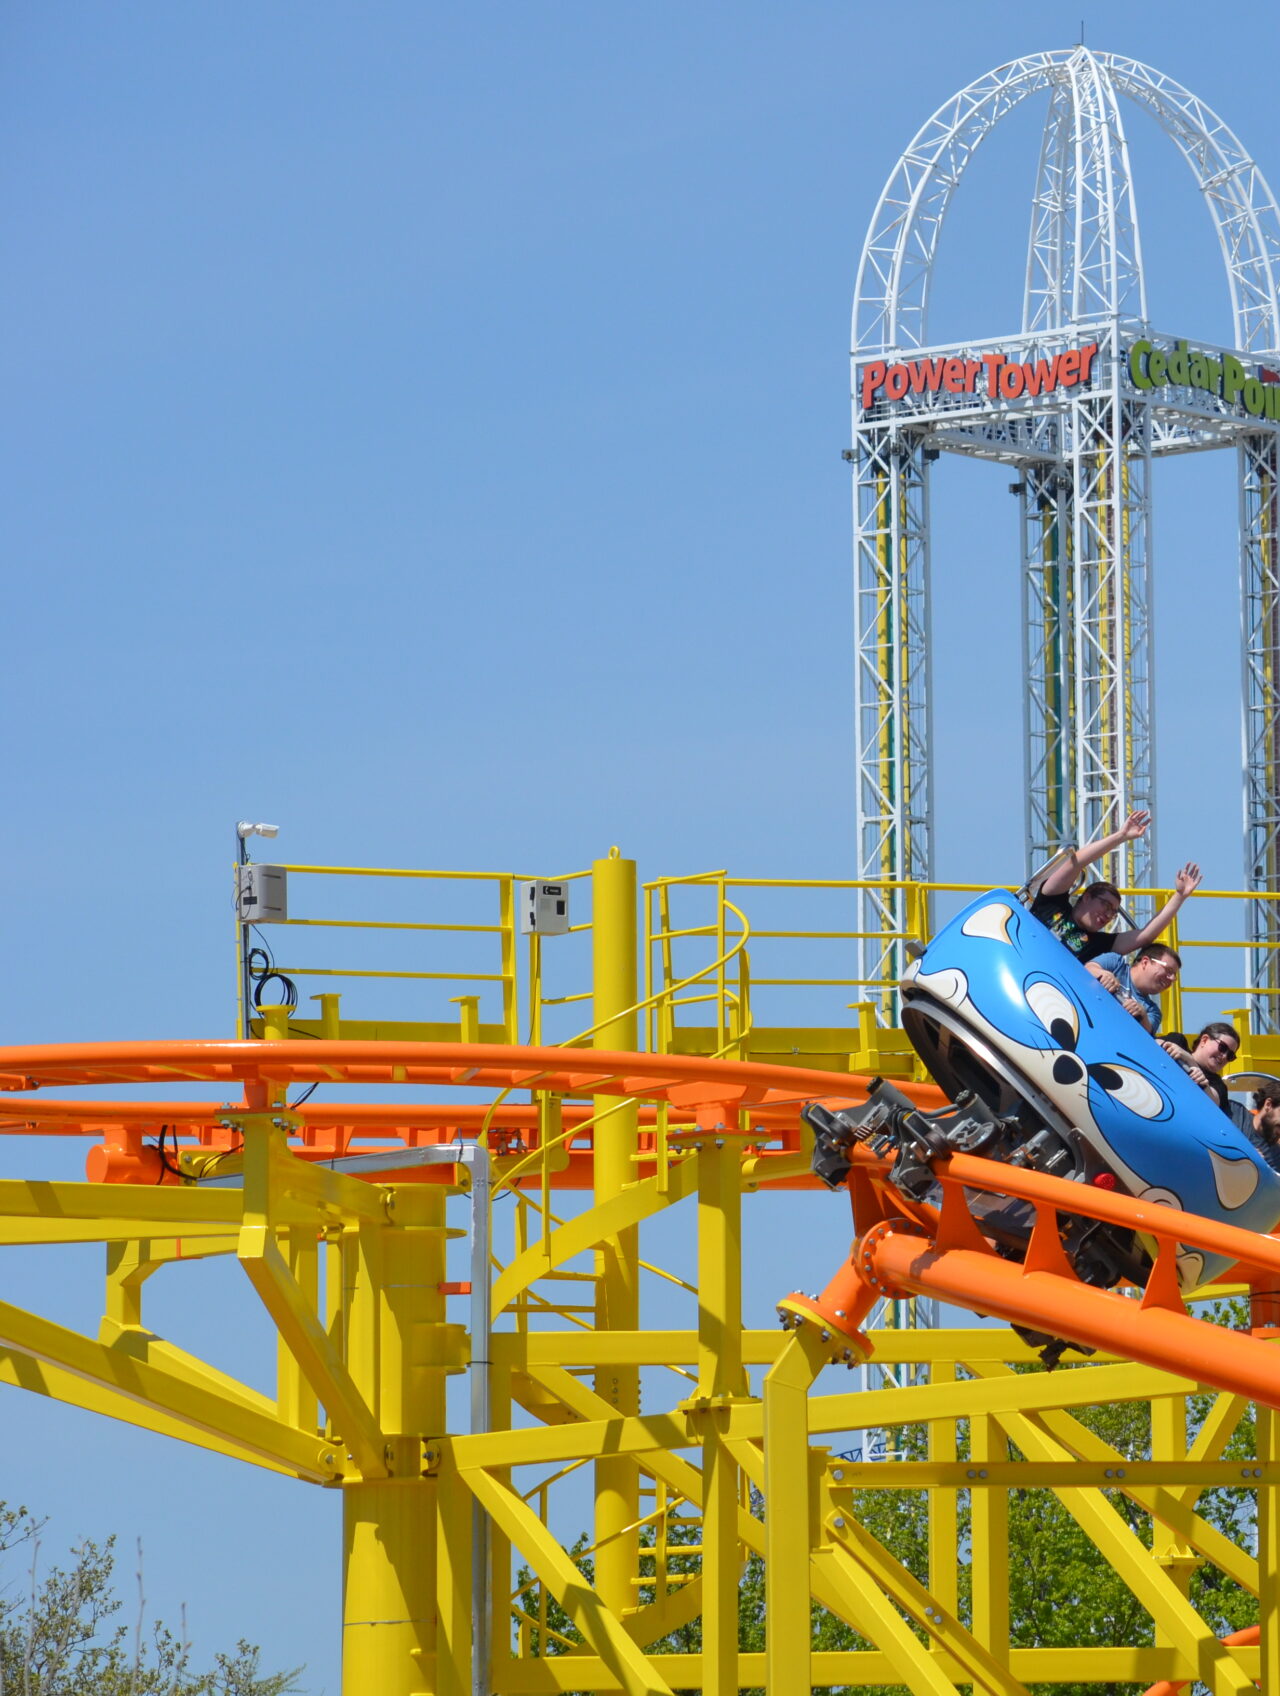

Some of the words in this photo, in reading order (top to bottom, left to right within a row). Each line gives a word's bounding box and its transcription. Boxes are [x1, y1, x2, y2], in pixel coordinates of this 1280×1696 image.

[862, 357, 982, 409] Power
[982, 342, 1098, 399] Tower
[1129, 340, 1222, 395] Cedar
